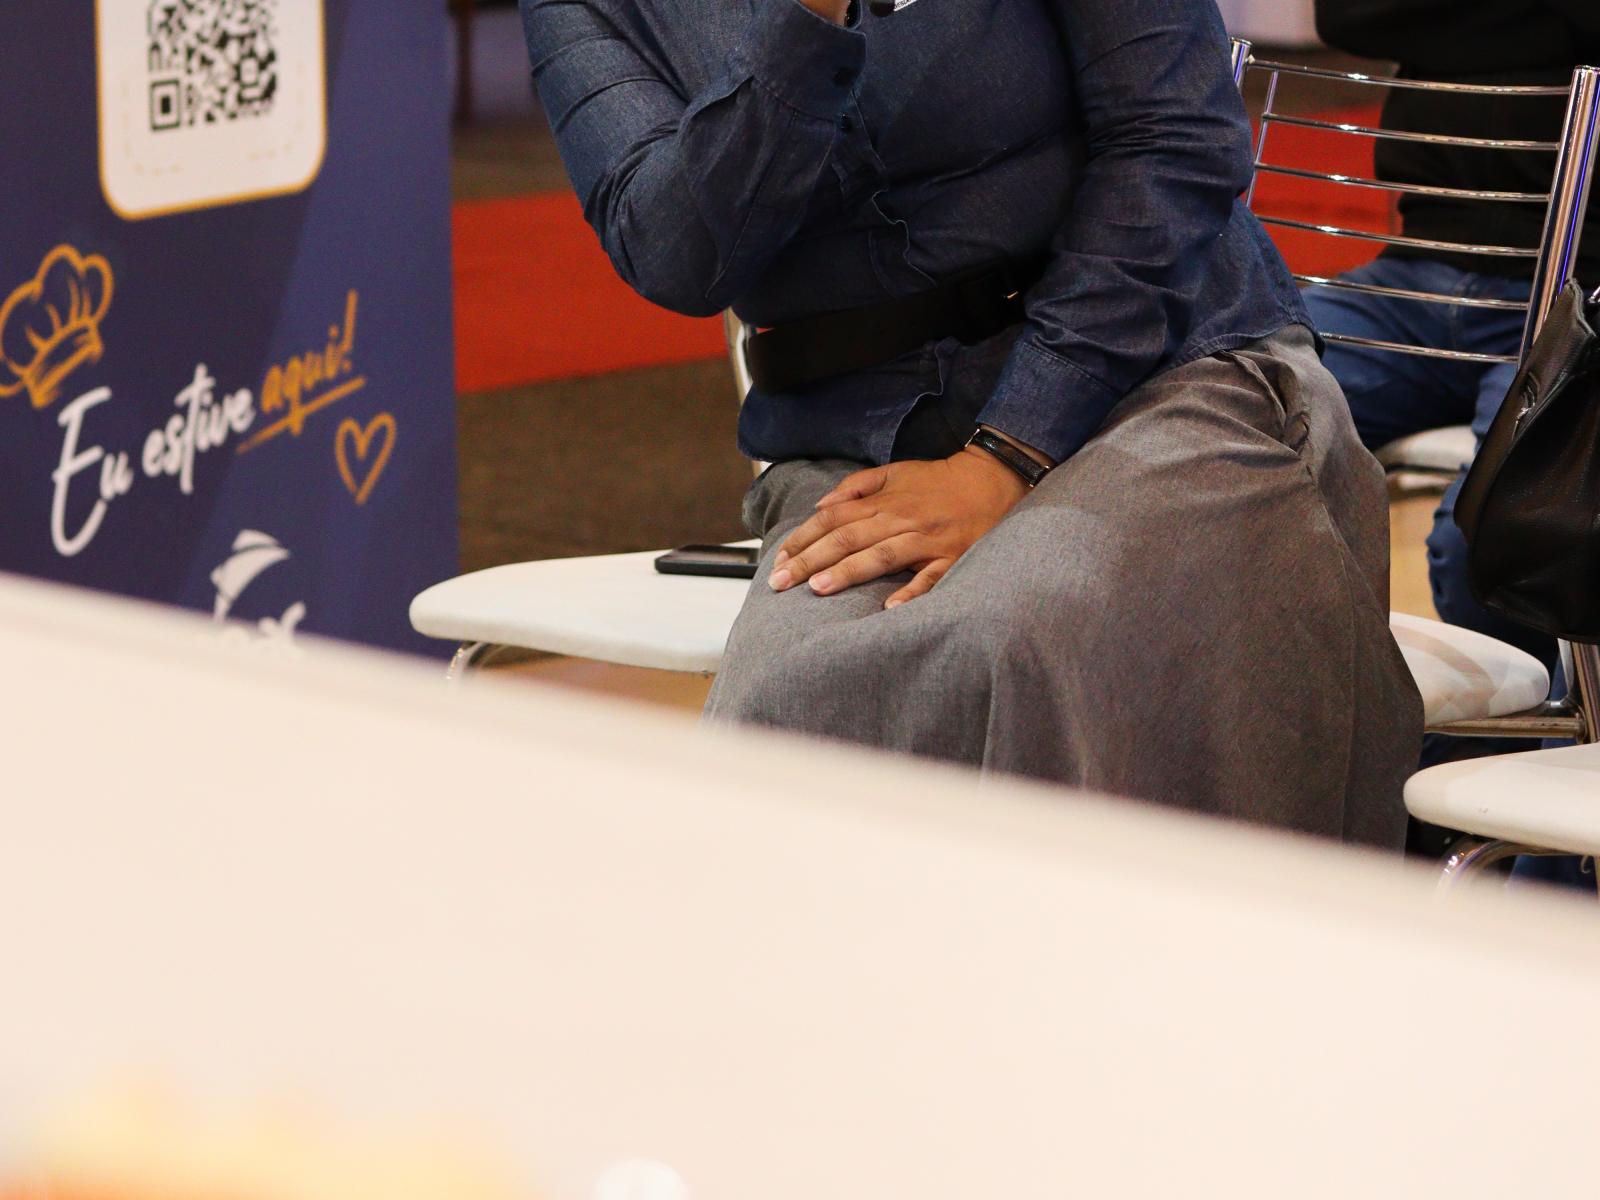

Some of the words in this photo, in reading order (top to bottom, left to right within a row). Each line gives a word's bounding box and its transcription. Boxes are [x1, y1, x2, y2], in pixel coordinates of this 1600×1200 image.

[51, 386, 133, 556] Eu
[143, 363, 256, 494] estive
[261, 288, 357, 437] aqui!
